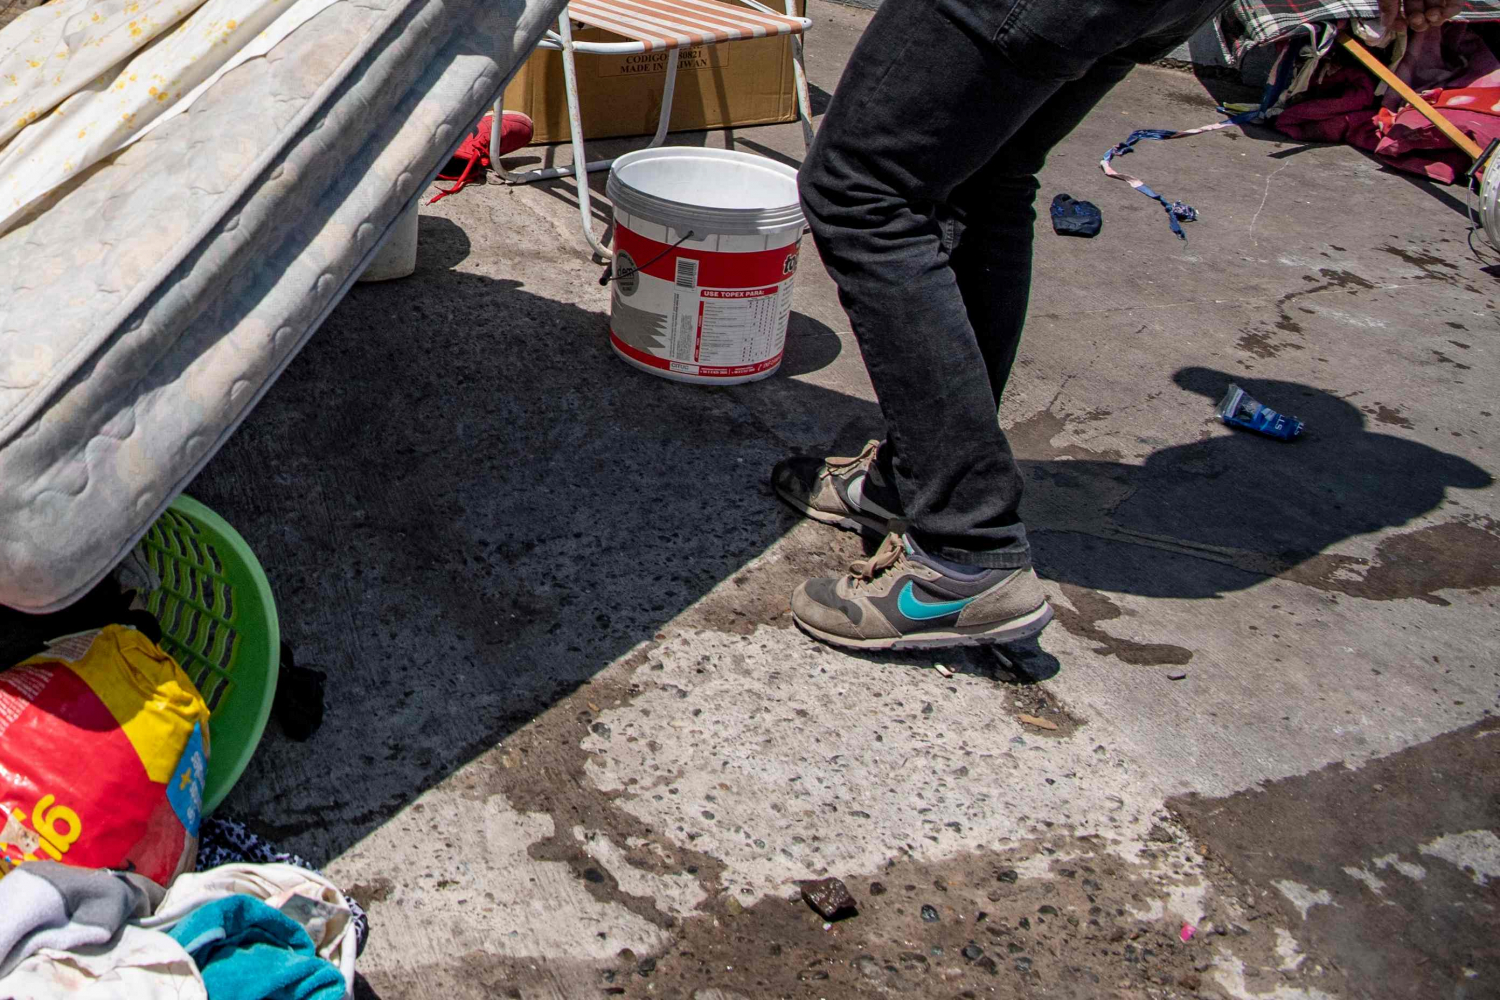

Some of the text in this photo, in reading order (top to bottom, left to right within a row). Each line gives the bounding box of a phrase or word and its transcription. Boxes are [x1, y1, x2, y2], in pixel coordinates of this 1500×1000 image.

[620, 64, 650, 73] MADE
[653, 63, 663, 71] IN
[703, 290, 721, 298] USE
